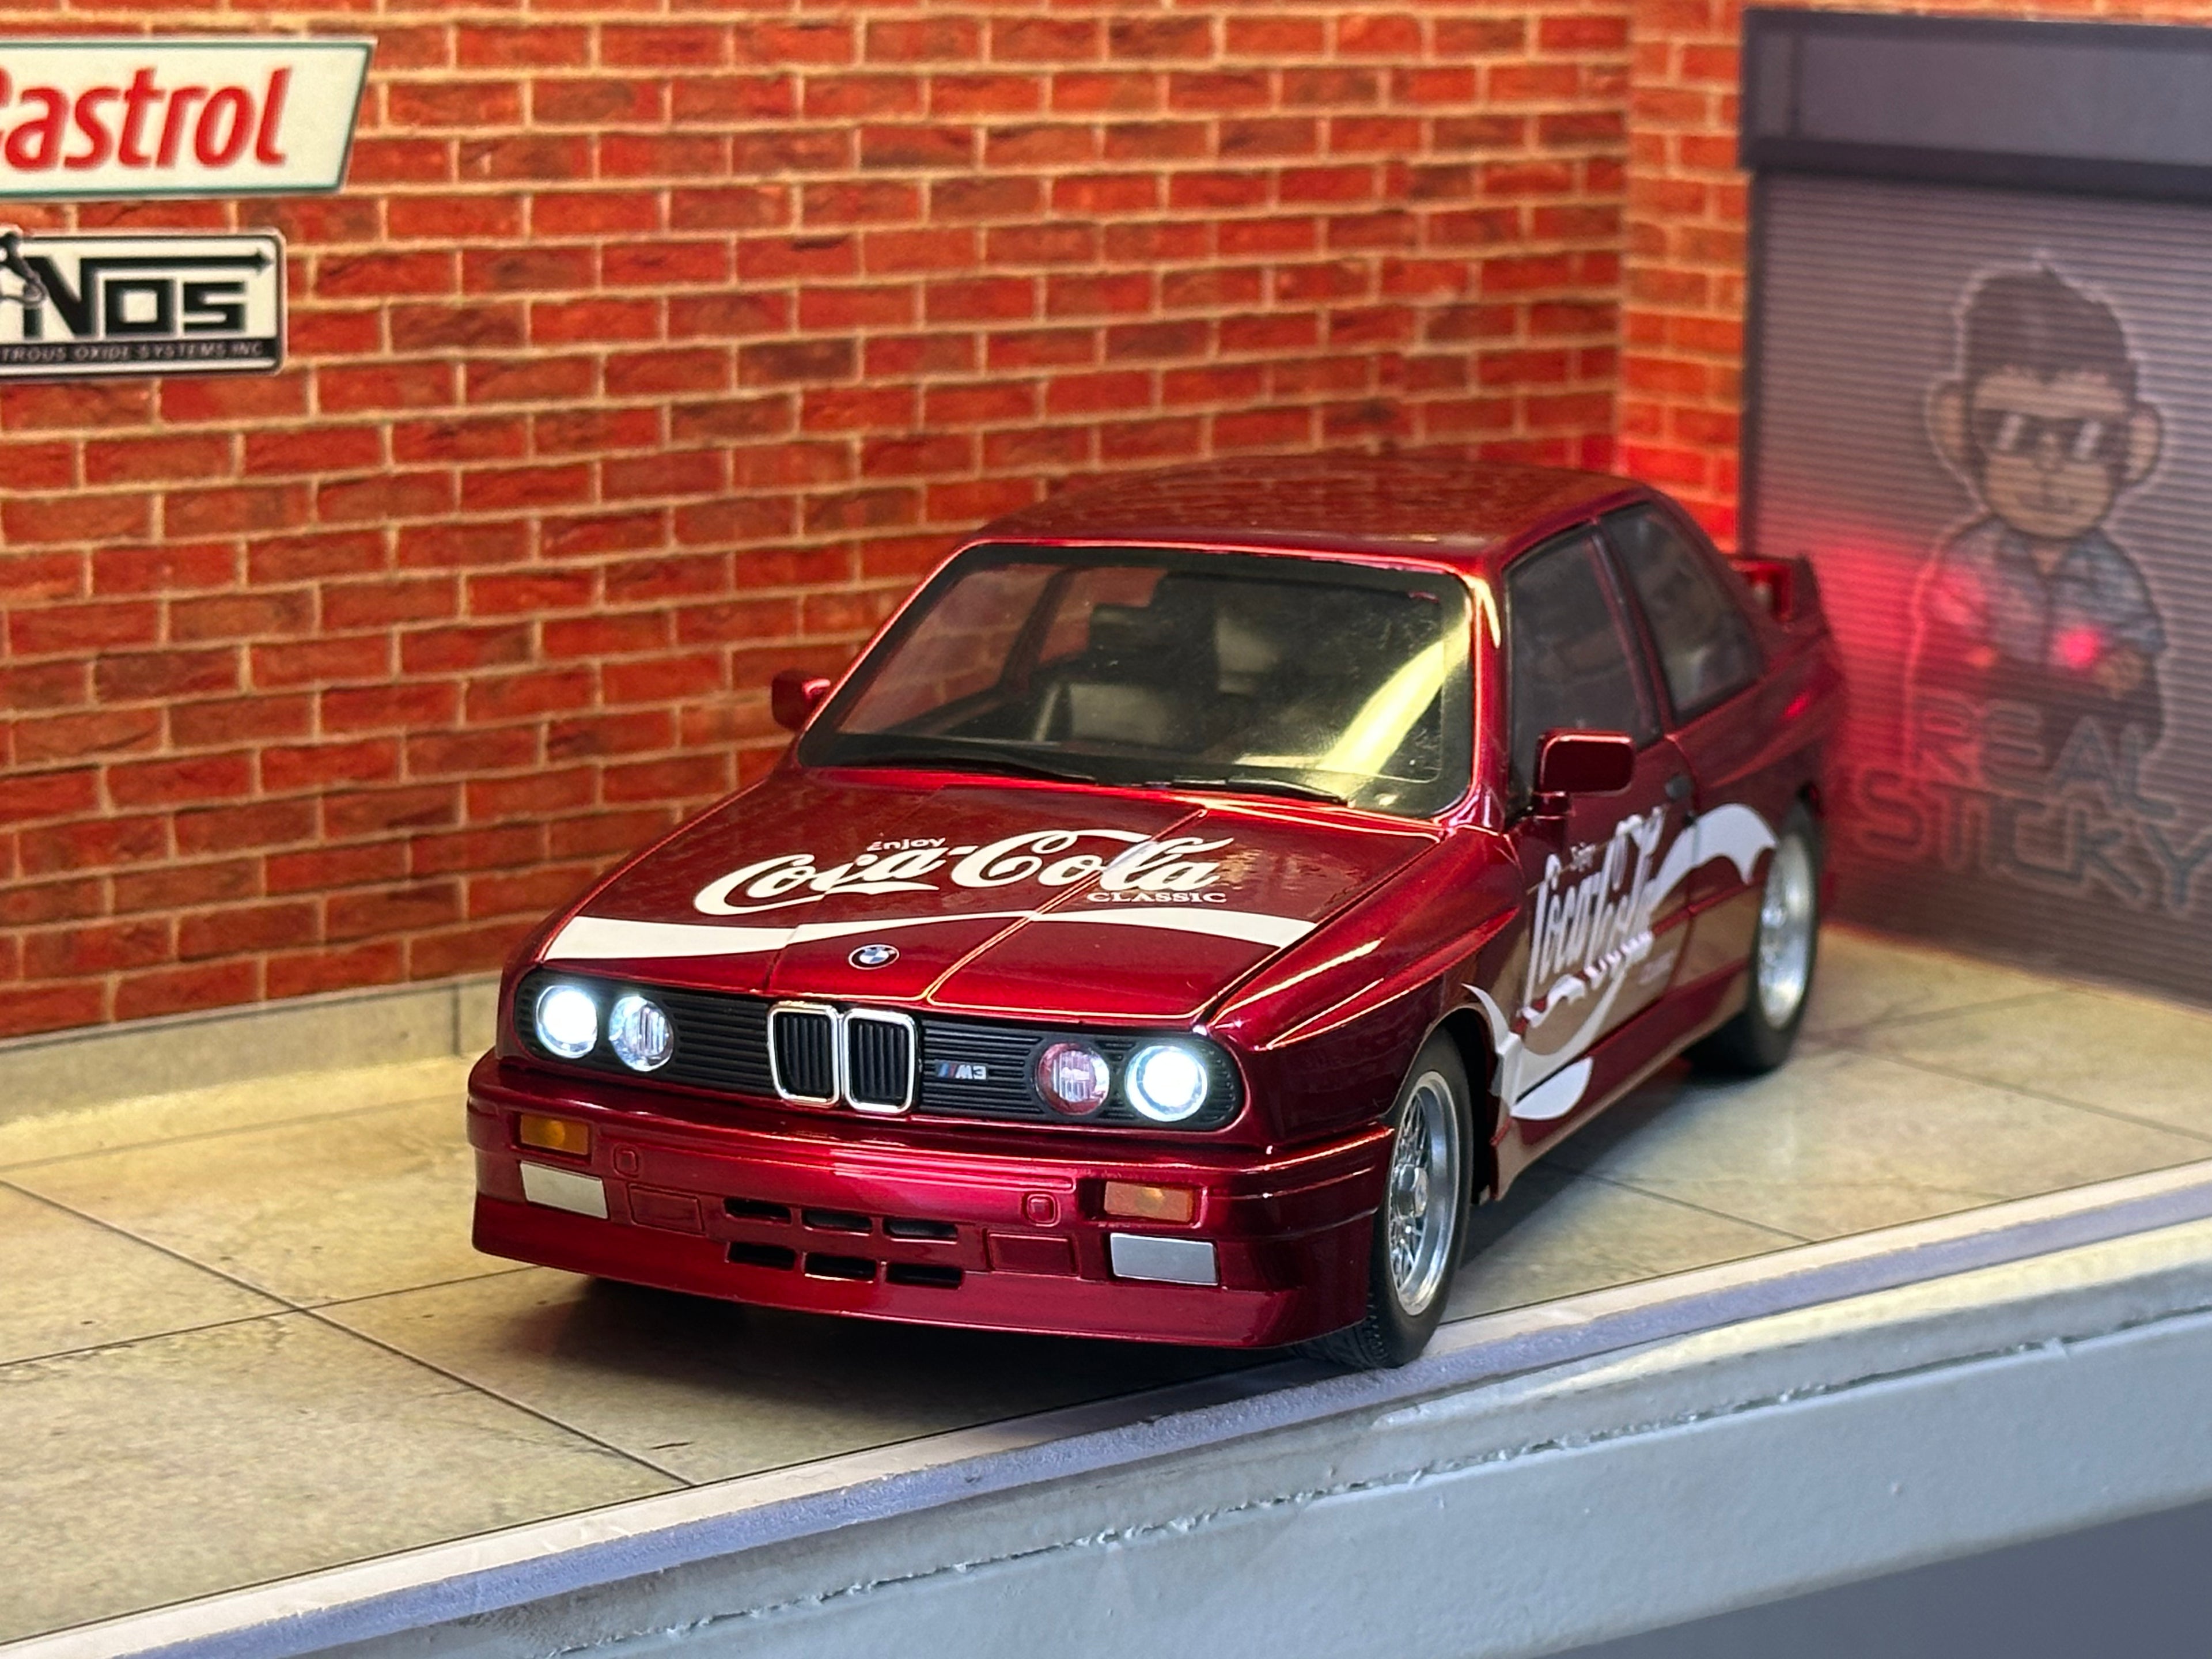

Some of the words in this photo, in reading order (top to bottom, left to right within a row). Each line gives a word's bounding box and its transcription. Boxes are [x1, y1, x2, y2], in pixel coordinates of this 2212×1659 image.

[0, 66, 292, 172] astrol
[23, 256, 247, 336] NOS
[694, 829, 1234, 916] Coca-Cola
[1086, 891, 1228, 903] CLASSIC
